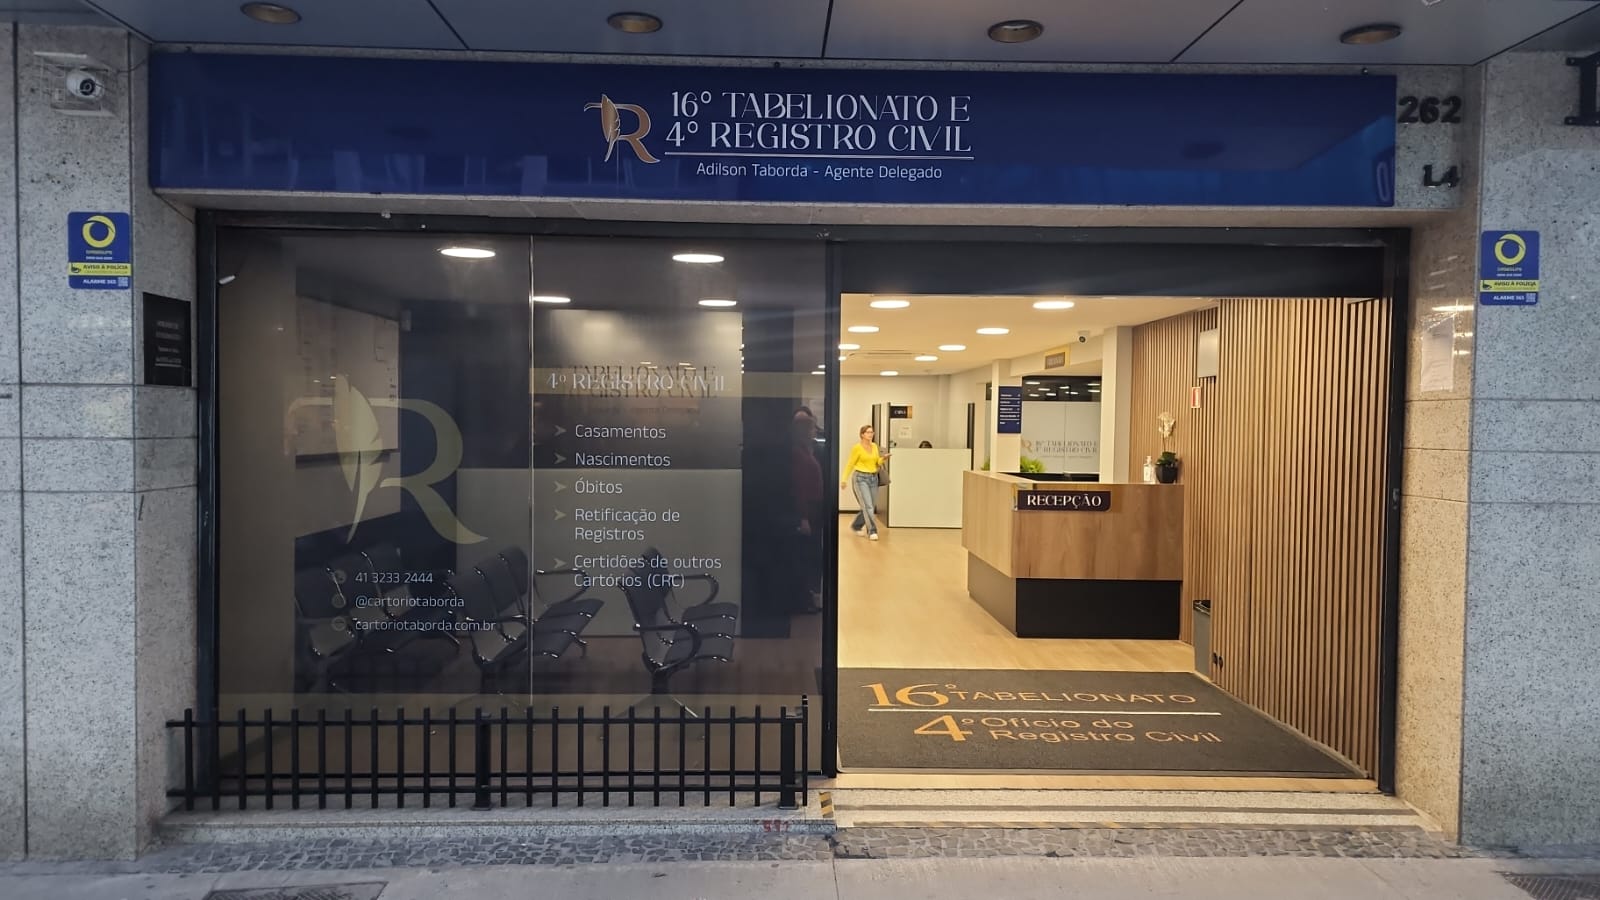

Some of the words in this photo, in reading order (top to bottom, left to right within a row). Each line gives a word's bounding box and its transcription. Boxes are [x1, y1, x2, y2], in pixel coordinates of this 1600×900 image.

[722, 92, 939, 122] TABELIONATO
[951, 96, 971, 122] E
[1398, 95, 1463, 124] 262
[711, 121, 876, 151] REGISTRO
[888, 124, 972, 152] CIVIL
[697, 162, 747, 176] Adilson
[752, 163, 808, 178] Taborda
[824, 164, 874, 180] Agente
[879, 165, 943, 181] Delegado
[1422, 164, 1460, 188] L4
[573, 374, 674, 391] REGISTRO
[575, 424, 667, 439] Casamentos
[575, 452, 671, 467] Nascimentos
[574, 477, 623, 494] Óbitos
[1027, 493, 1102, 509] RECEPÇÃO
[574, 508, 657, 525] Retificação
[662, 508, 681, 522] de
[574, 527, 645, 543] Registros
[574, 554, 646, 569] Certidões
[650, 555, 668, 569] de
[673, 556, 722, 569] outros
[355, 572, 368, 584] 41
[371, 572, 401, 584] 3233
[403, 572, 433, 584] 2444
[574, 573, 642, 588] Cartórios
[647, 574, 686, 589] (CRC)
[355, 595, 465, 609] @cartoriotaborda
[355, 620, 497, 632] cartoriotaborda.com.br
[950, 691, 1196, 704] TABELIONATO
[1092, 719, 1134, 729] do
[989, 729, 1136, 743] Registro
[1145, 730, 1223, 743] Civil
